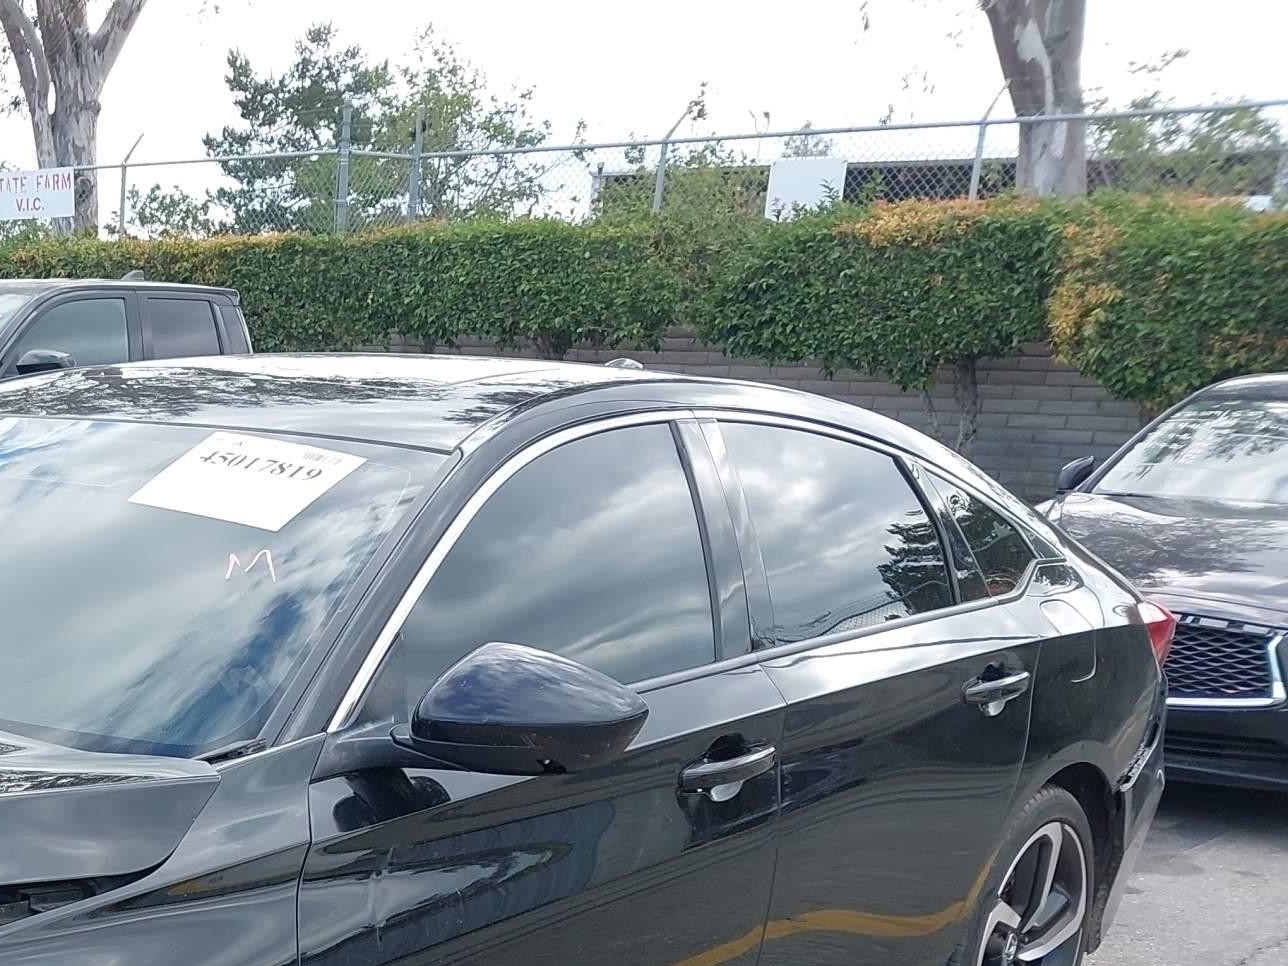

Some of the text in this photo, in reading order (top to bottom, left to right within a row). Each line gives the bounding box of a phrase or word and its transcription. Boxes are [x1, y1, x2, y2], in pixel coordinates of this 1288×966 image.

[36, 173, 71, 192] FARM
[15, 197, 45, 213] V.I.C.
[200, 450, 323, 480] 45017819
